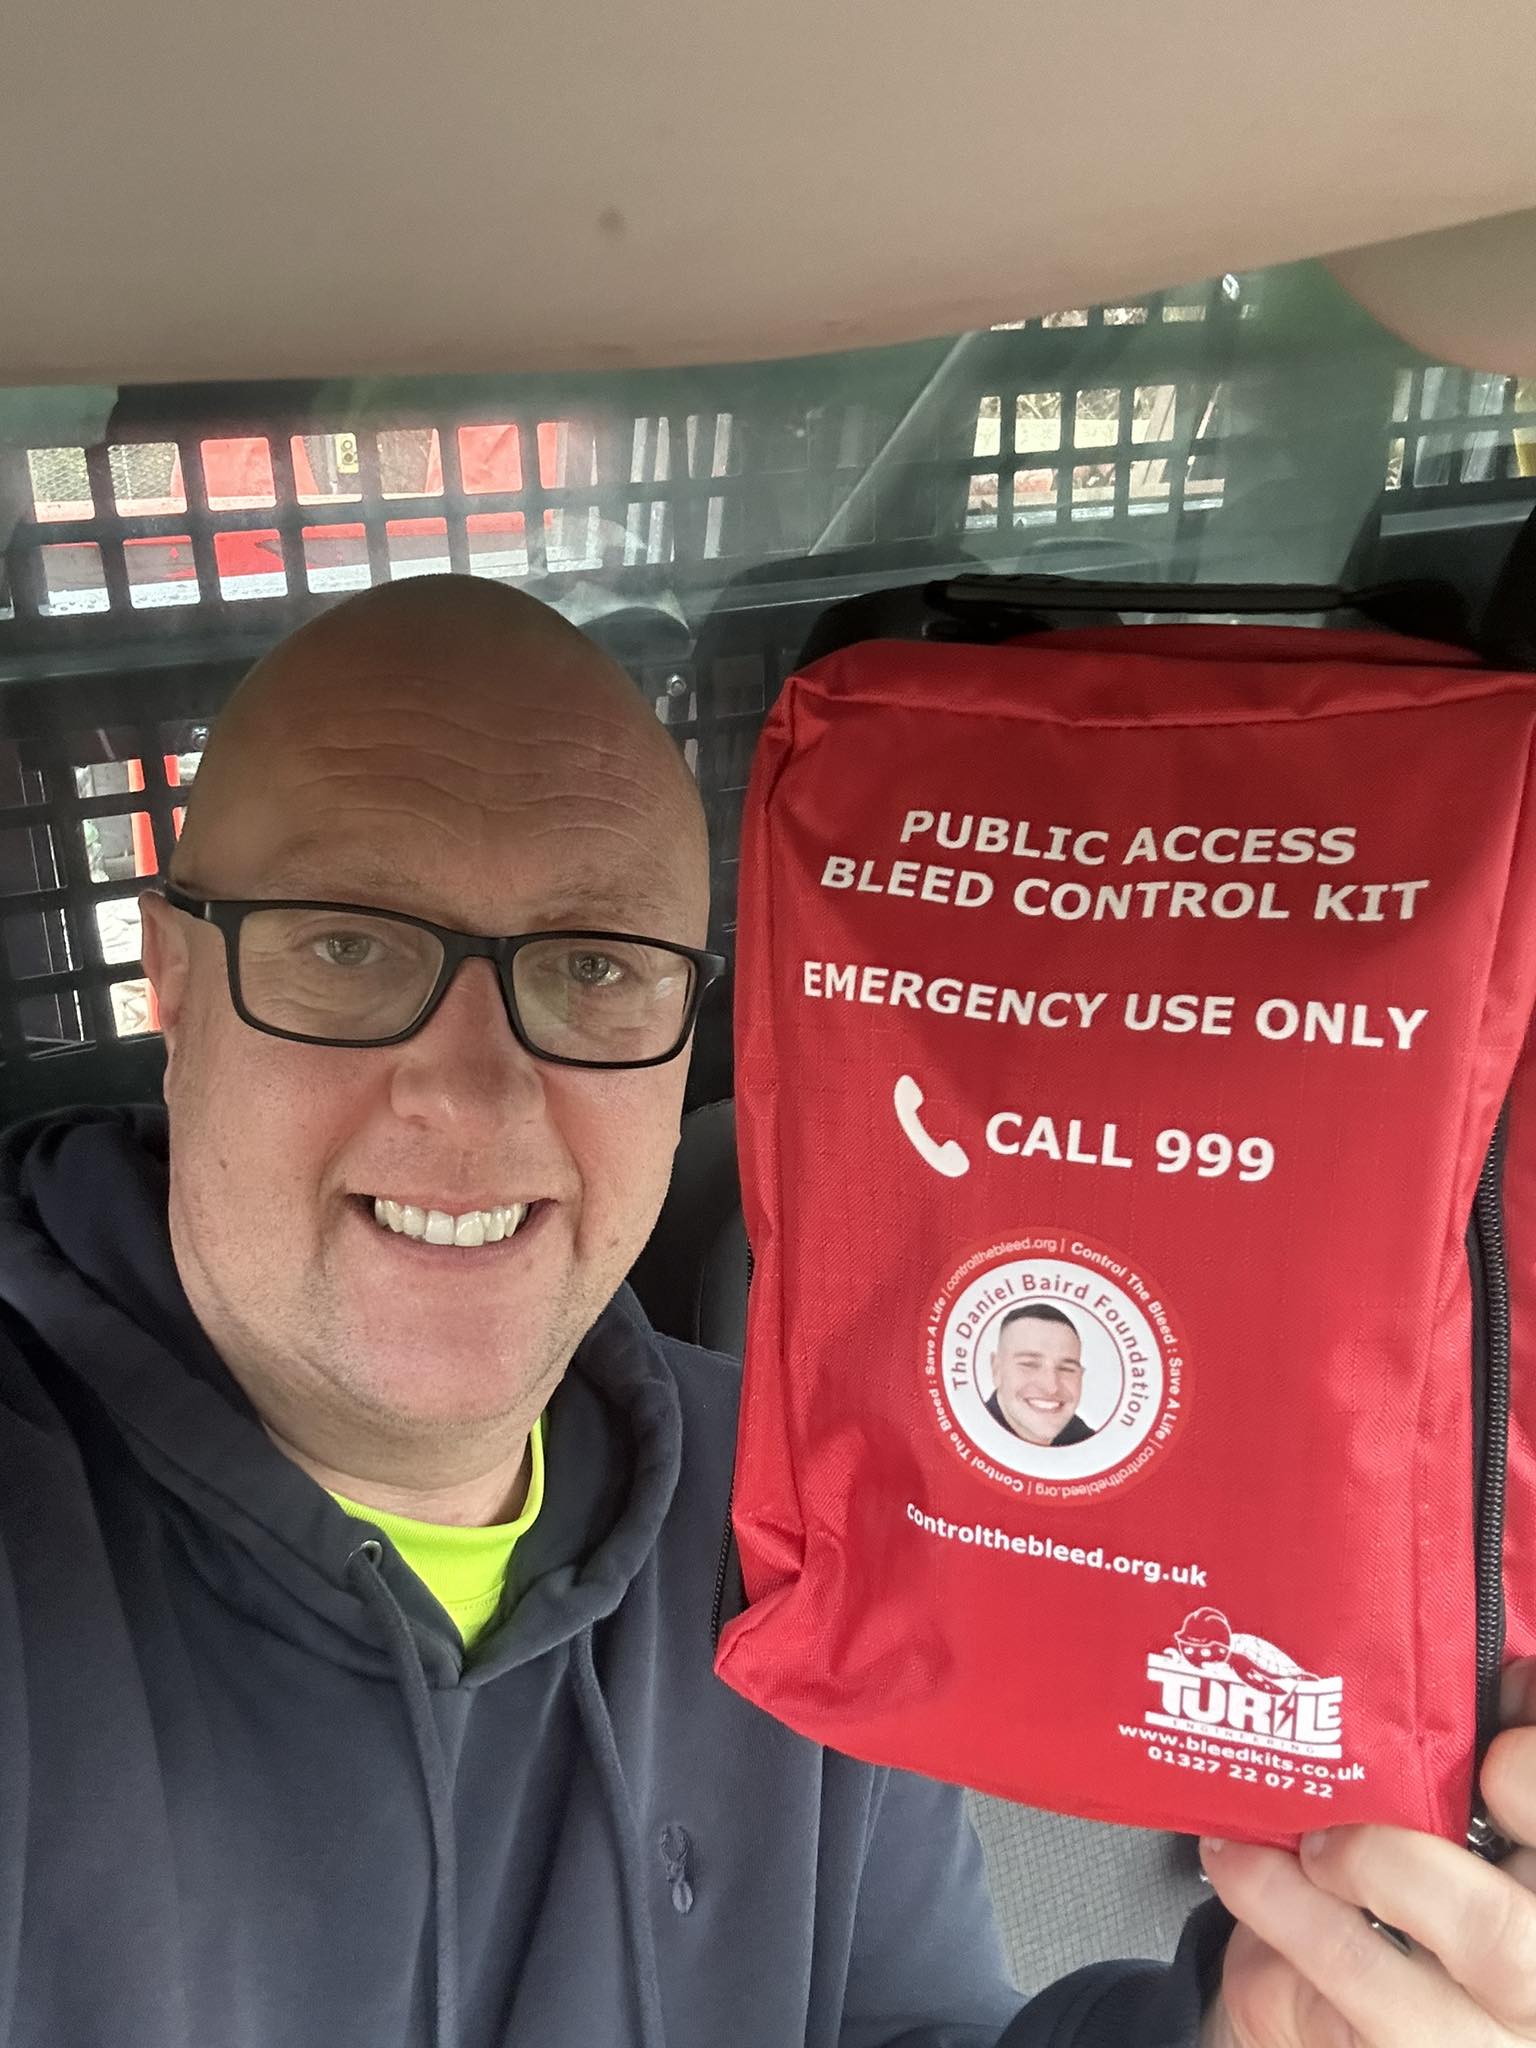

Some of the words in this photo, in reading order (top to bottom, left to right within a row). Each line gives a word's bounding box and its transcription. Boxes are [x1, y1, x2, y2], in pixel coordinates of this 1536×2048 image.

[900, 810, 1108, 865] PUBLIC
[1122, 826, 1357, 866] ACCESS
[821, 856, 994, 907] BLEED
[1013, 878, 1290, 921] CONTROL
[1314, 879, 1430, 922] KIT
[804, 960, 1107, 1030] EMERGENCY
[1123, 993, 1235, 1035] USE
[1256, 999, 1429, 1050] ONLY
[985, 1112, 1133, 1168] CALL
[1155, 1129, 1275, 1182] 999
[1071, 1242, 1128, 1277] Control
[1022, 1274, 1090, 1300] Baird
[1126, 1273, 1150, 1301] The
[956, 1279, 1014, 1339] Daniel
[1148, 1301, 1178, 1344] Bleed
[925, 1339, 936, 1375] Save
[951, 1347, 968, 1390] The
[1094, 1294, 1148, 1427] Foundation
[1169, 1357, 1183, 1395] Save
[929, 1388, 952, 1431] Bleed
[1155, 1413, 1177, 1440] Life
[950, 1432, 971, 1460] The
[971, 1456, 1024, 1492] Control
[907, 1503, 1207, 1587] controlthebleed.org.uk
[1147, 1667, 1343, 1744] TURTLE
[1118, 1723, 1365, 1780] www.bleedkits.co.uk
[1148, 1746, 1220, 1773] 01327
[1229, 1763, 1258, 1783] 22
[1265, 1772, 1295, 1790] 07
[1303, 1780, 1333, 1799] 22
